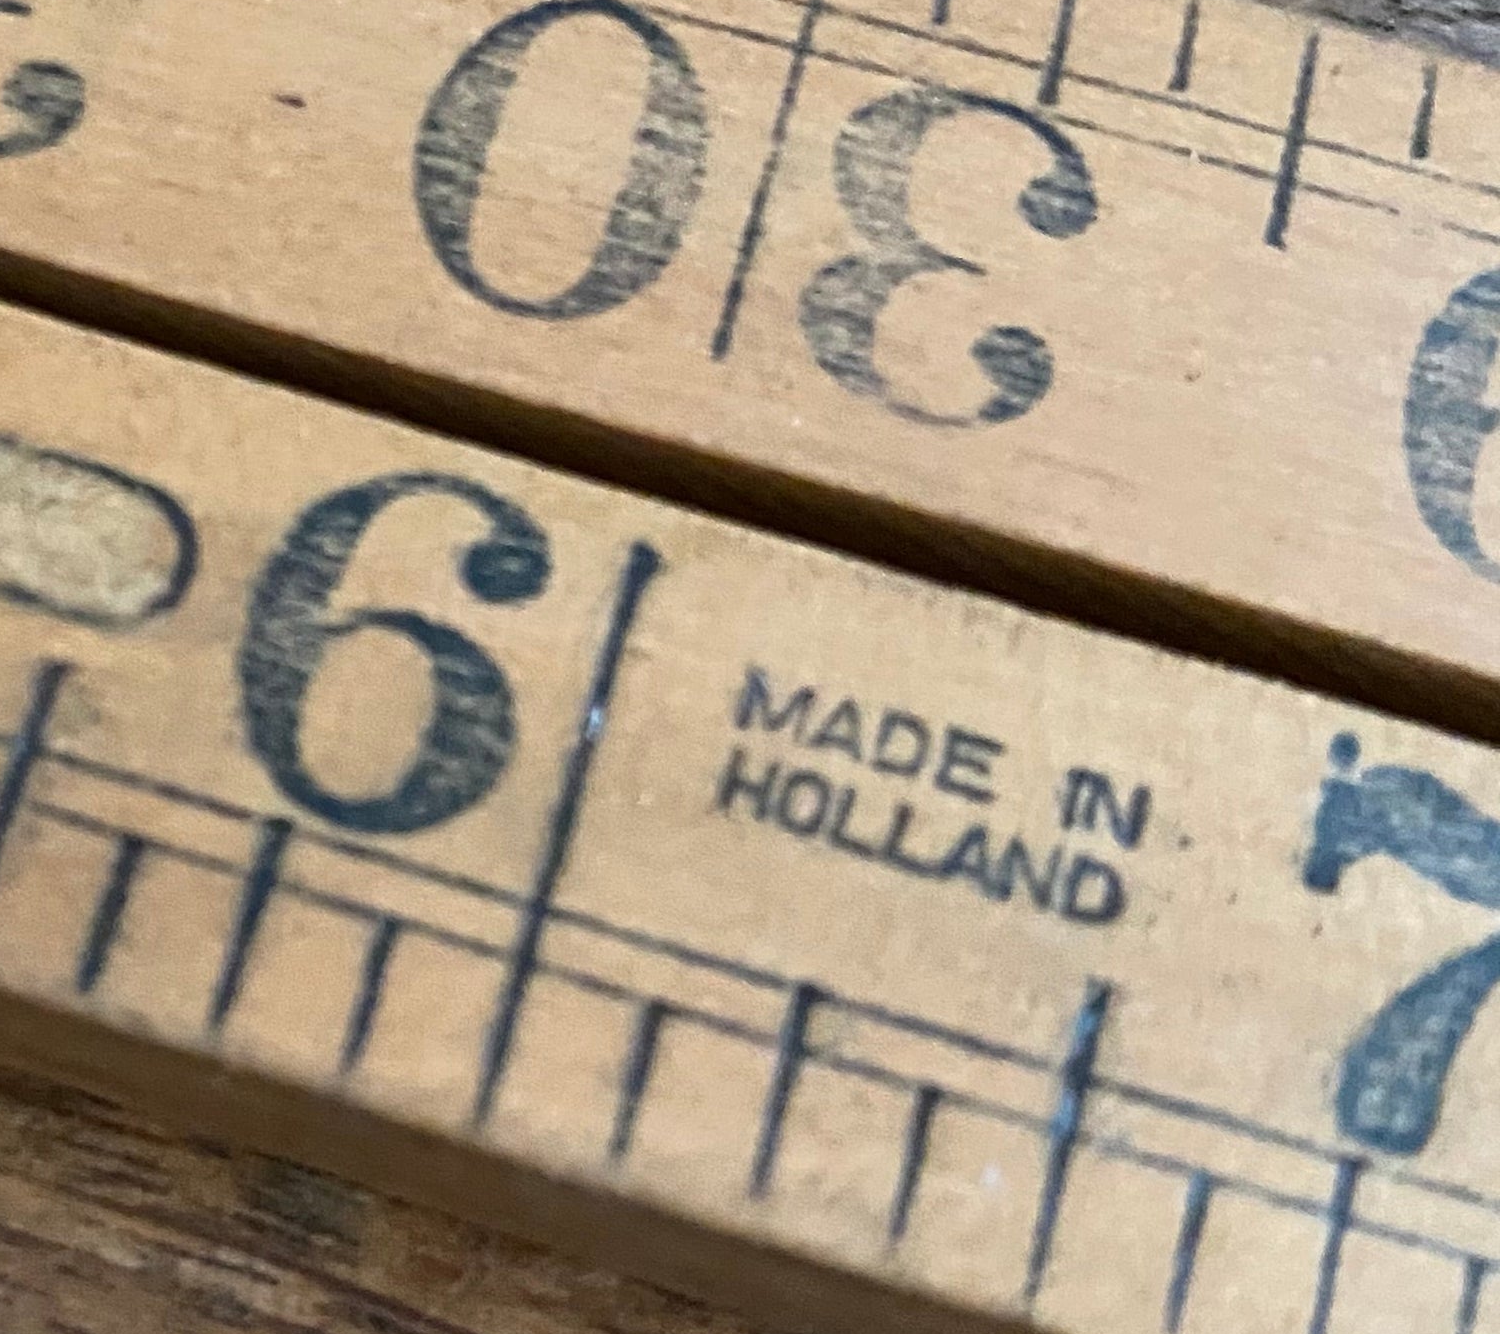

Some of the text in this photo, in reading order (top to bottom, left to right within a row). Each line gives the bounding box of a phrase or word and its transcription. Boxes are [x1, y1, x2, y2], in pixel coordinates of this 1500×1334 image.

[237, 470, 554, 838] 6
[714, 747, 1128, 929] HOLLAND
[733, 665, 1152, 851] MADE IN
